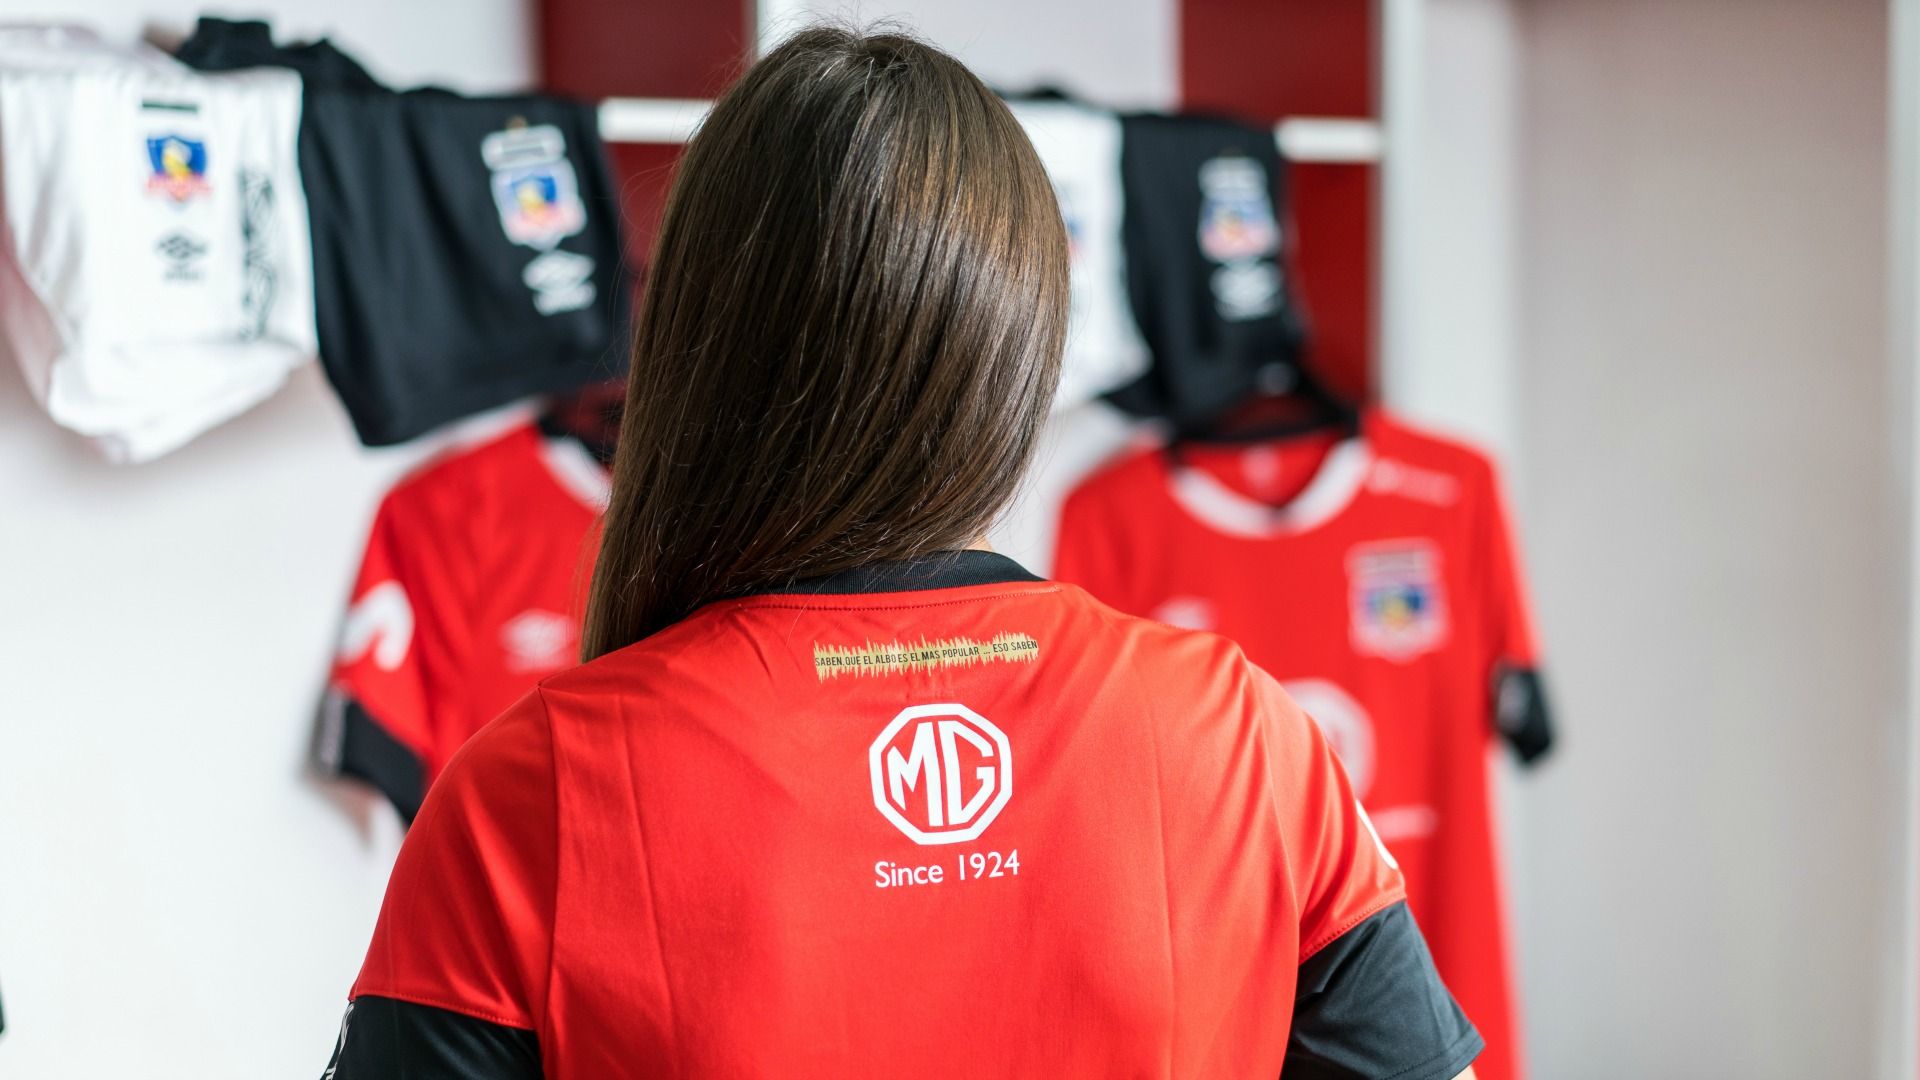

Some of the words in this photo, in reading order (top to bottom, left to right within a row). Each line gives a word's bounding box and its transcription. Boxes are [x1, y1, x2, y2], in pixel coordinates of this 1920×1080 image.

[845, 656, 861, 666] QUE
[863, 655, 873, 665] EL
[875, 653, 897, 664] ALBO
[898, 653, 908, 663] ES
[910, 652, 920, 662] EL
[921, 650, 940, 661] MAS
[942, 646, 980, 658] POPULAR
[993, 642, 1009, 653] ESO
[1011, 640, 1038, 651] SABEN
[887, 720, 996, 827] MG
[874, 861, 944, 888] Since
[959, 849, 1020, 881] 1924
